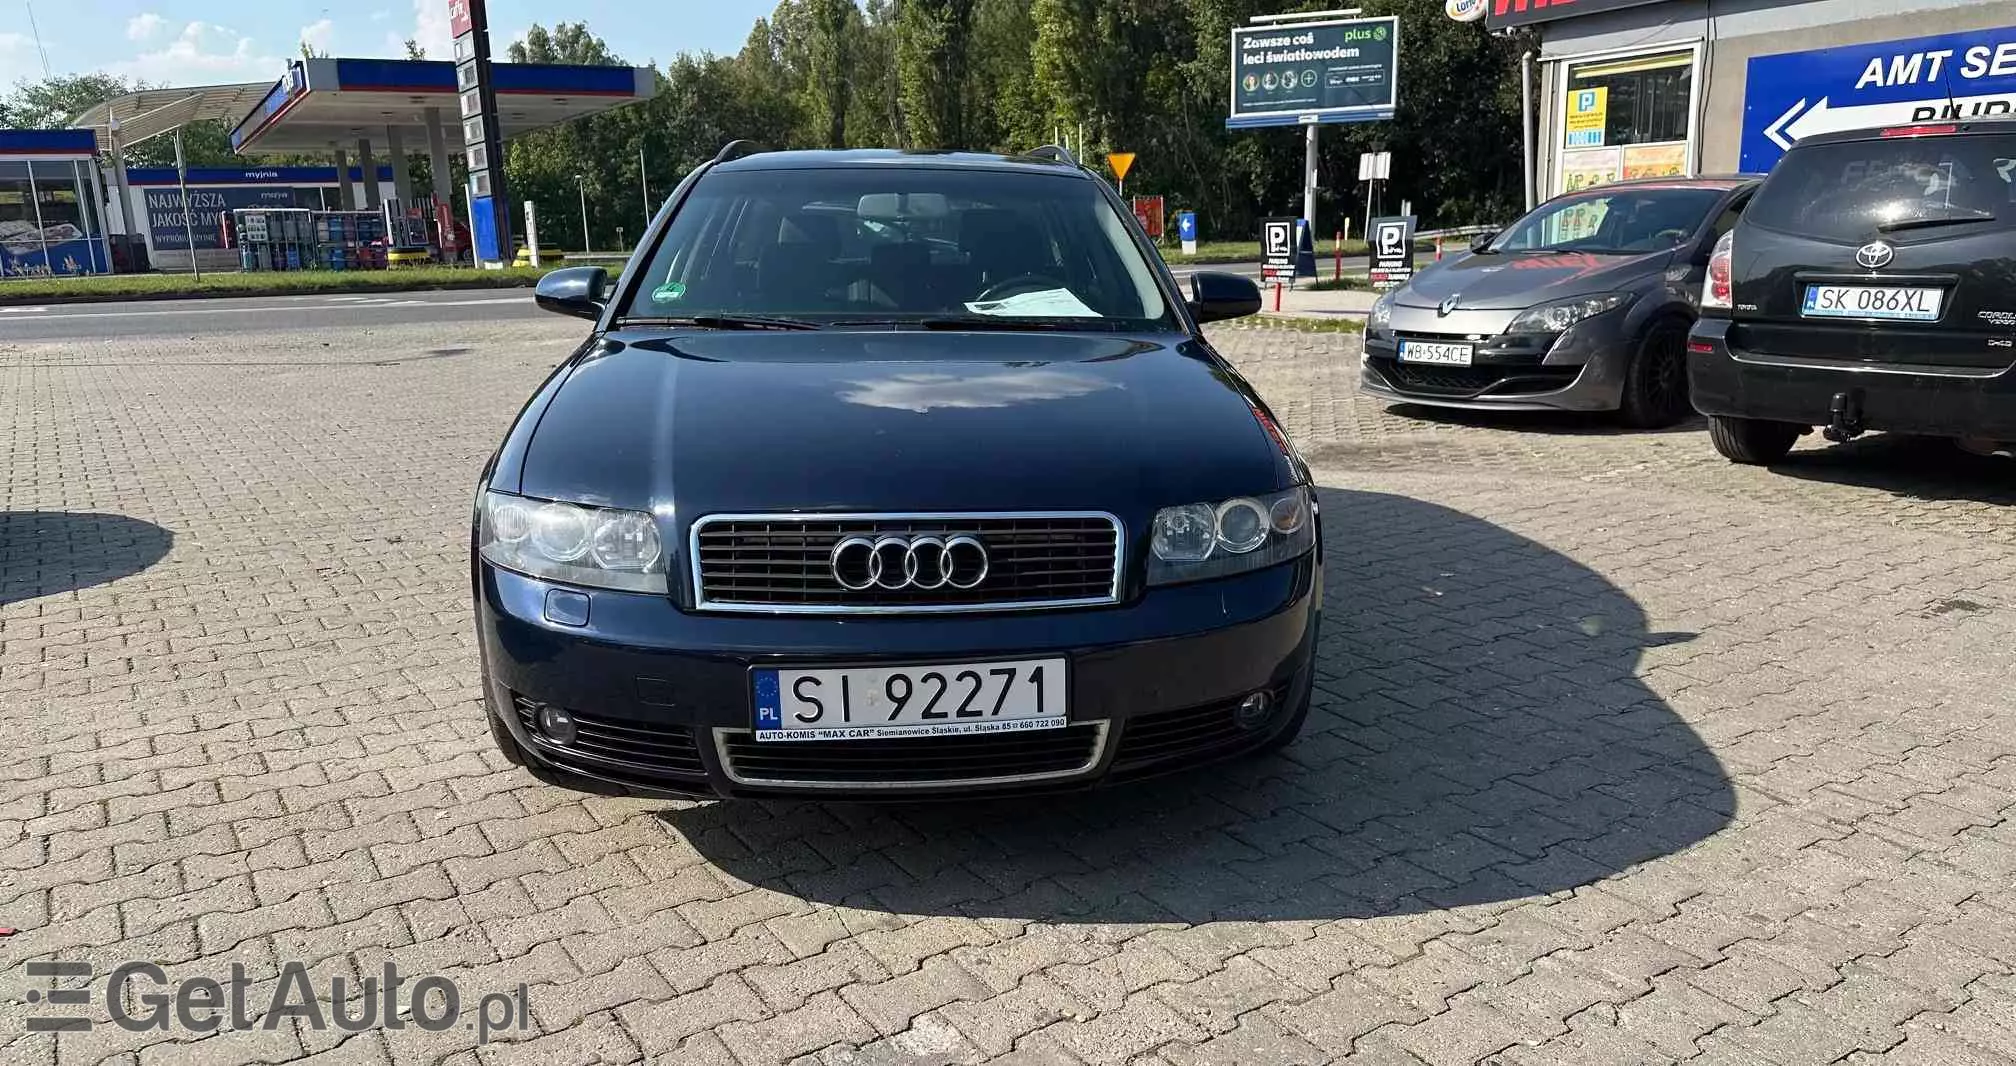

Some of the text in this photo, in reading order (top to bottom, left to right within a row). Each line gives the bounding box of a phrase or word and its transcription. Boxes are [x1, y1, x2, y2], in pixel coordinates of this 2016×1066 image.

[1242, 32, 1315, 49] Zawsze coś
[1344, 28, 1372, 43] plus
[1242, 46, 1360, 65] leci światłowodem
[1855, 50, 1953, 89] AMT
[245, 170, 278, 179] myjnia
[149, 190, 226, 208] NAJWYŻSZA
[152, 209, 198, 228] JAKOŚĆ
[1820, 289, 1930, 312] SK 086XL
[1407, 343, 1422, 359] WB
[1427, 345, 1469, 362] 554CE
[791, 665, 1045, 723] SI 92271
[759, 707, 778, 721] PL
[759, 731, 816, 740] AUTO-KOMIS
